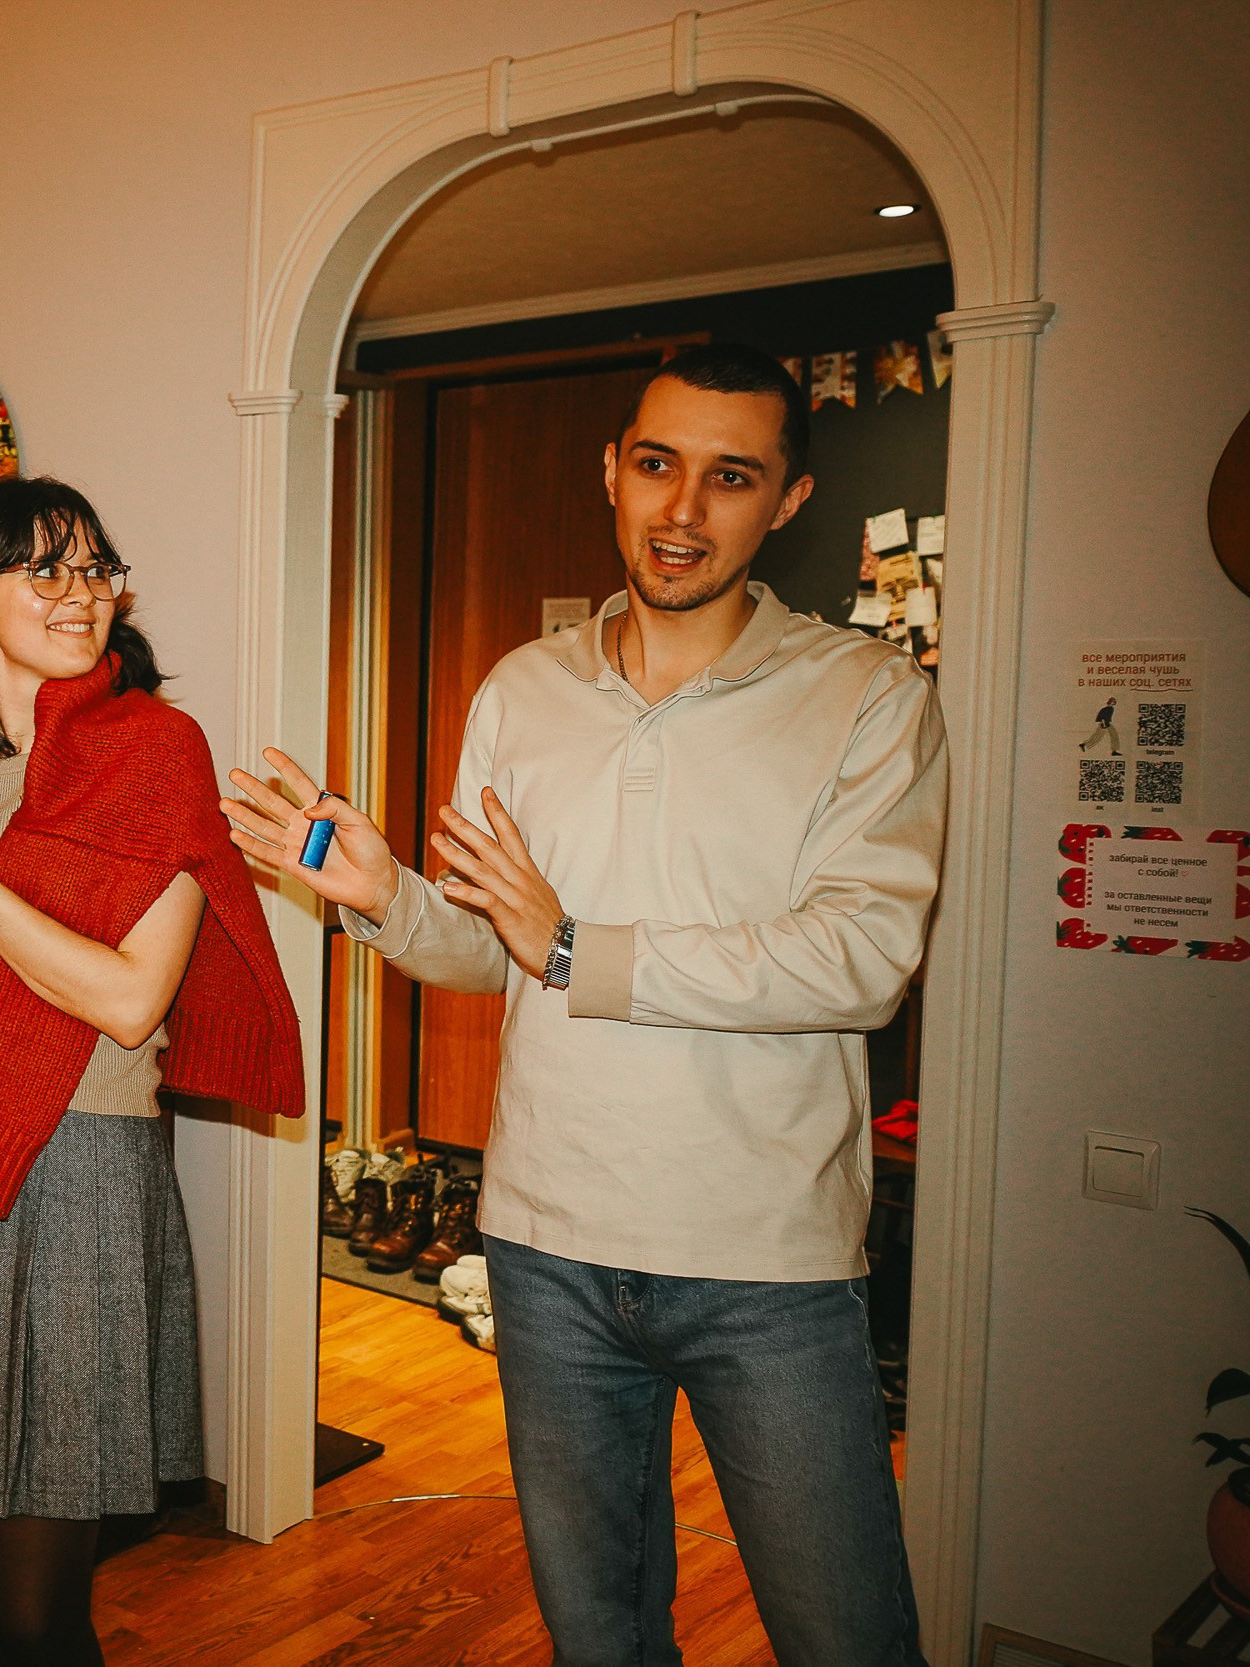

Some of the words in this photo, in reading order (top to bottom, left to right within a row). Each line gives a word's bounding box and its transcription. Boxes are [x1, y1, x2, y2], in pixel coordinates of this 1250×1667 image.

[1082, 653, 1102, 663] все
[1105, 653, 1186, 665] мероприятия
[1087, 666, 1094, 675] и
[1098, 665, 1146, 675] веселая
[1149, 665, 1180, 677] чушь
[1078, 678, 1085, 687] в
[1088, 678, 1126, 687] наших
[1129, 678, 1154, 689] соц.
[1158, 678, 1192, 687] сетях
[1146, 749, 1175, 757] telegram
[1109, 853, 1149, 865] забирай
[1151, 857, 1169, 865] все
[1171, 858, 1208, 867] ценное
[1138, 868, 1144, 876] с
[1146, 867, 1179, 878] собой!
[1104, 891, 1115, 899] за
[1117, 891, 1183, 903] оставленные
[1185, 896, 1212, 906] вещи
[1106, 903, 1122, 911] мы
[1124, 904, 1209, 917] ответственности
[1134, 917, 1145, 926] не
[1148, 918, 1179, 928] несем
